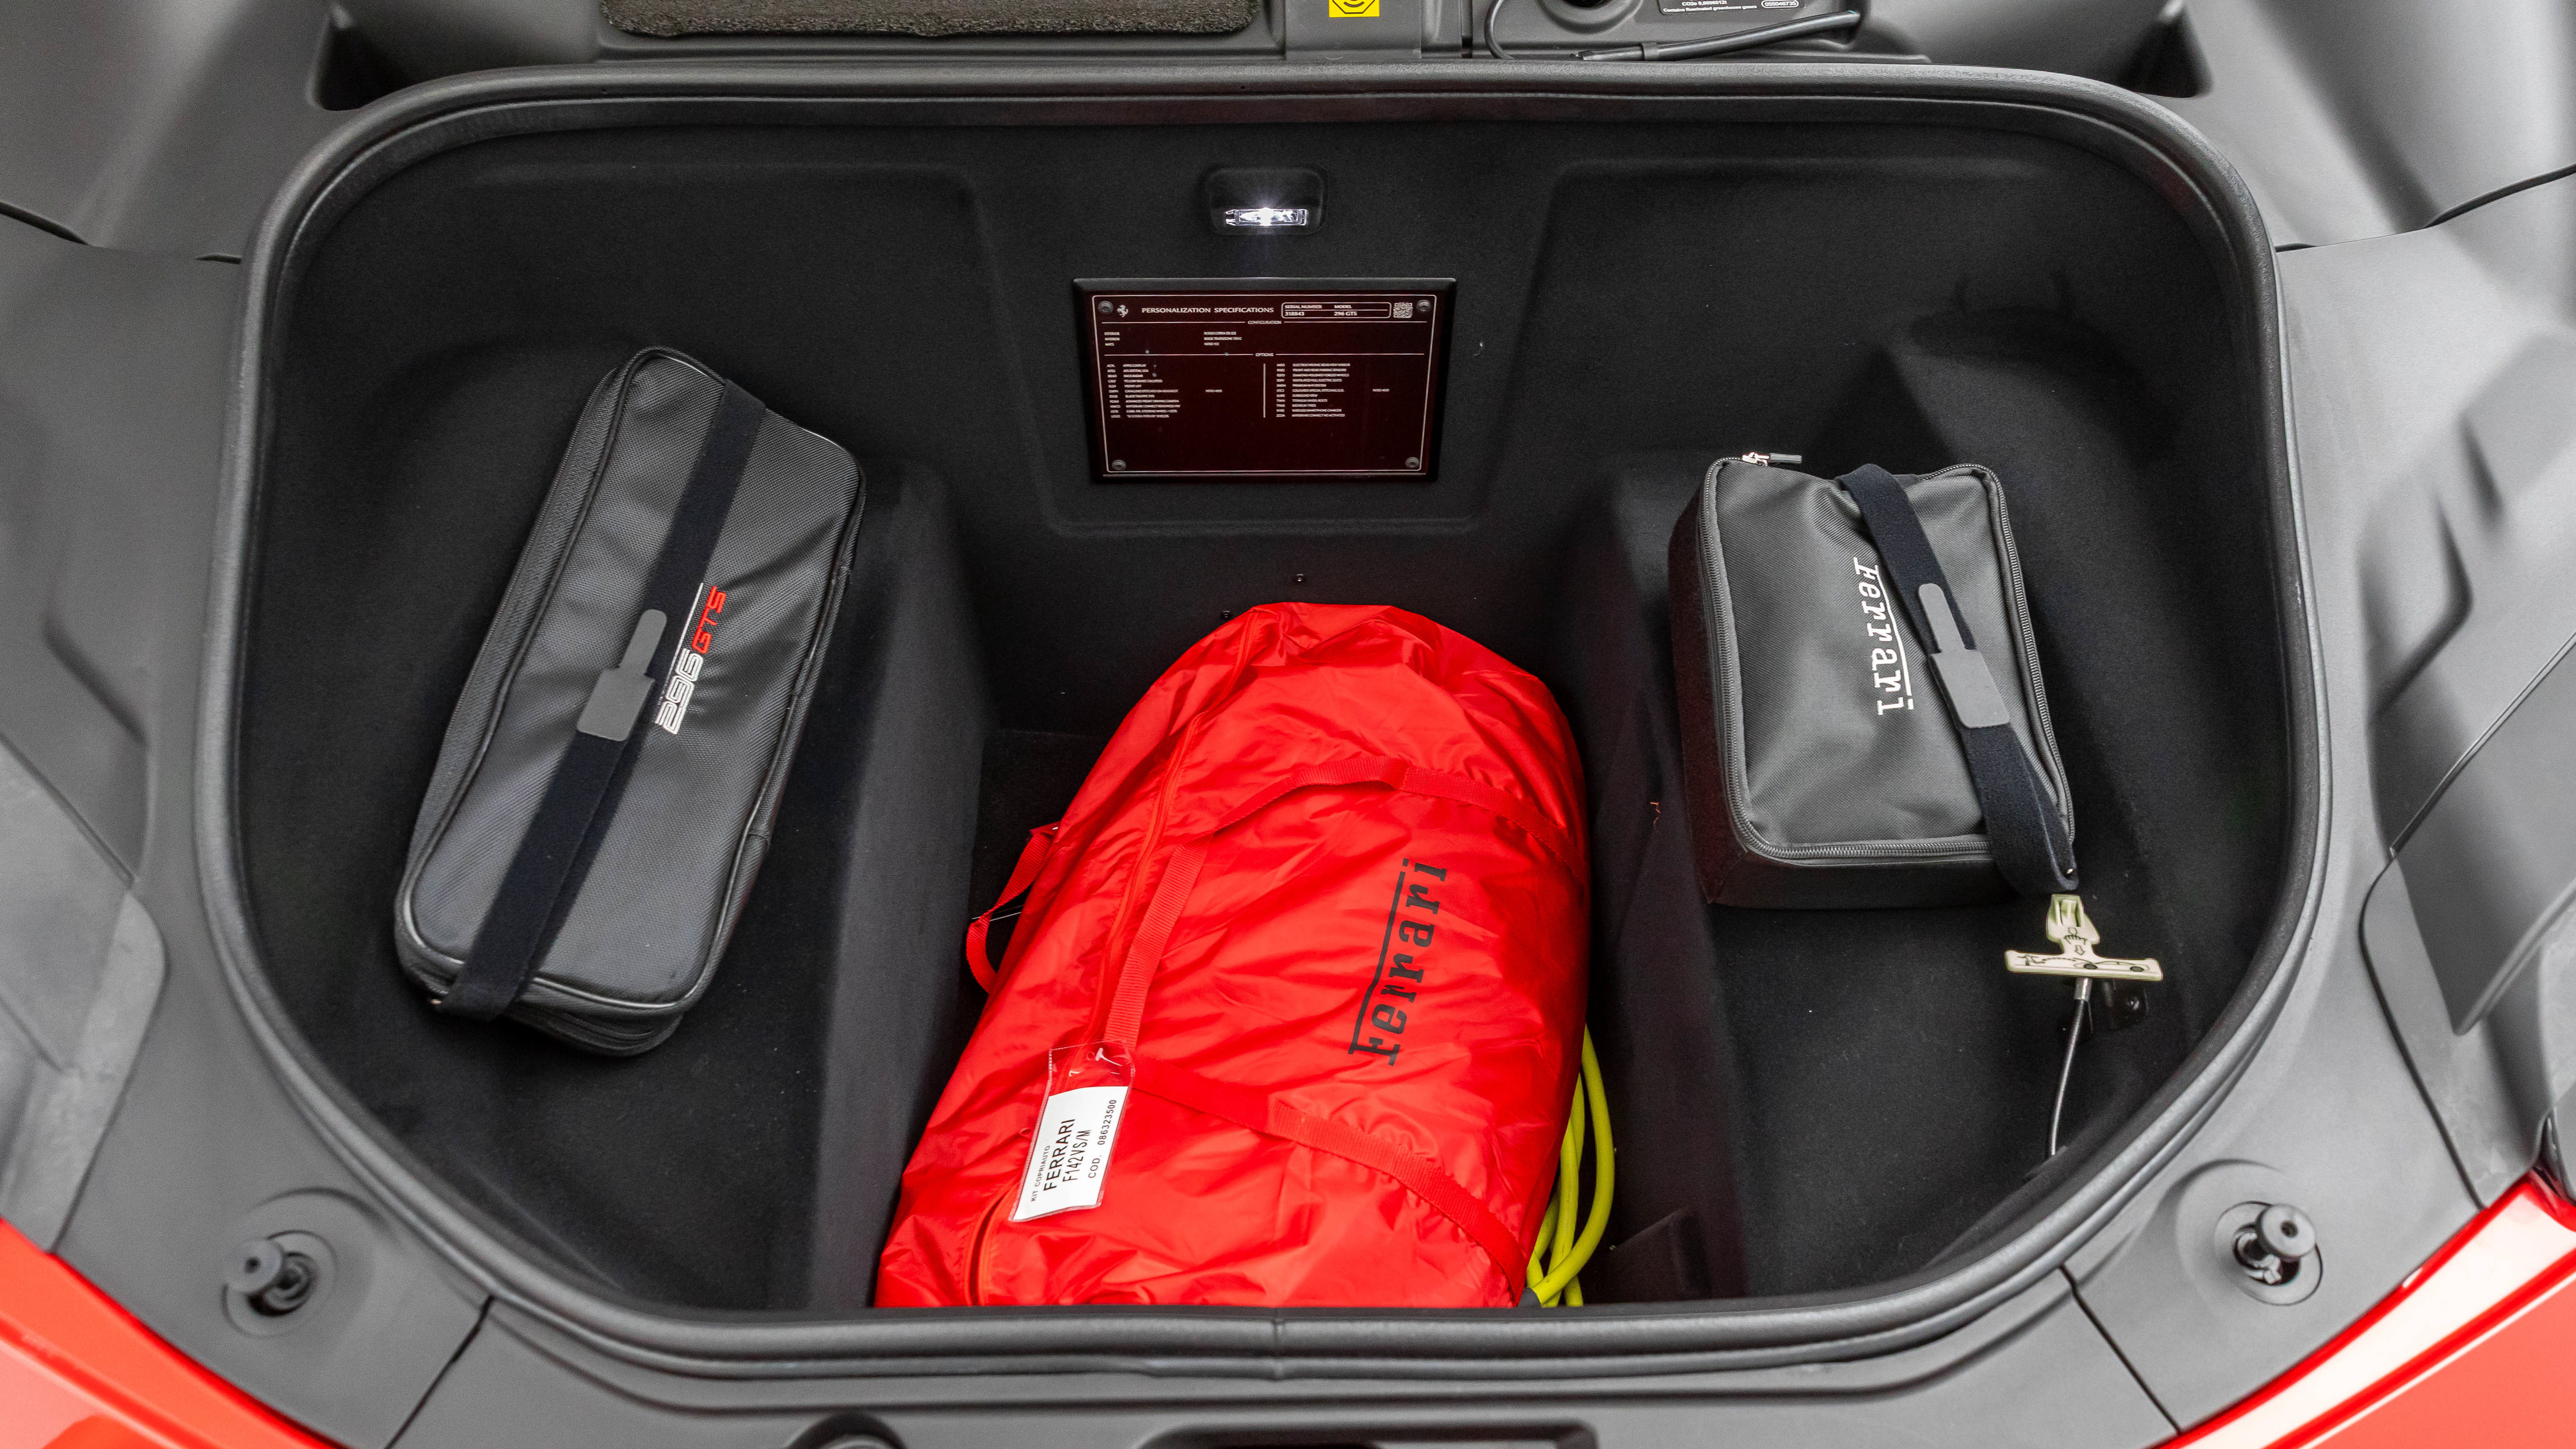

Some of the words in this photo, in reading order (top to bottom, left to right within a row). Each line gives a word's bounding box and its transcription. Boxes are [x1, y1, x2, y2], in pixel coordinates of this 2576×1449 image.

[691, 586, 727, 654] GTS
[1853, 557, 1914, 715] Ferrari
[1348, 858, 1447, 1066] Ferrari
[1035, 1145, 1051, 1187] COPRIAUTO
[1043, 1119, 1076, 1191] FERRARI
[1062, 1129, 1091, 1182] F142VS/M
[1088, 1155, 1102, 1178] COD.
[1097, 1099, 1117, 1145] 086323500
